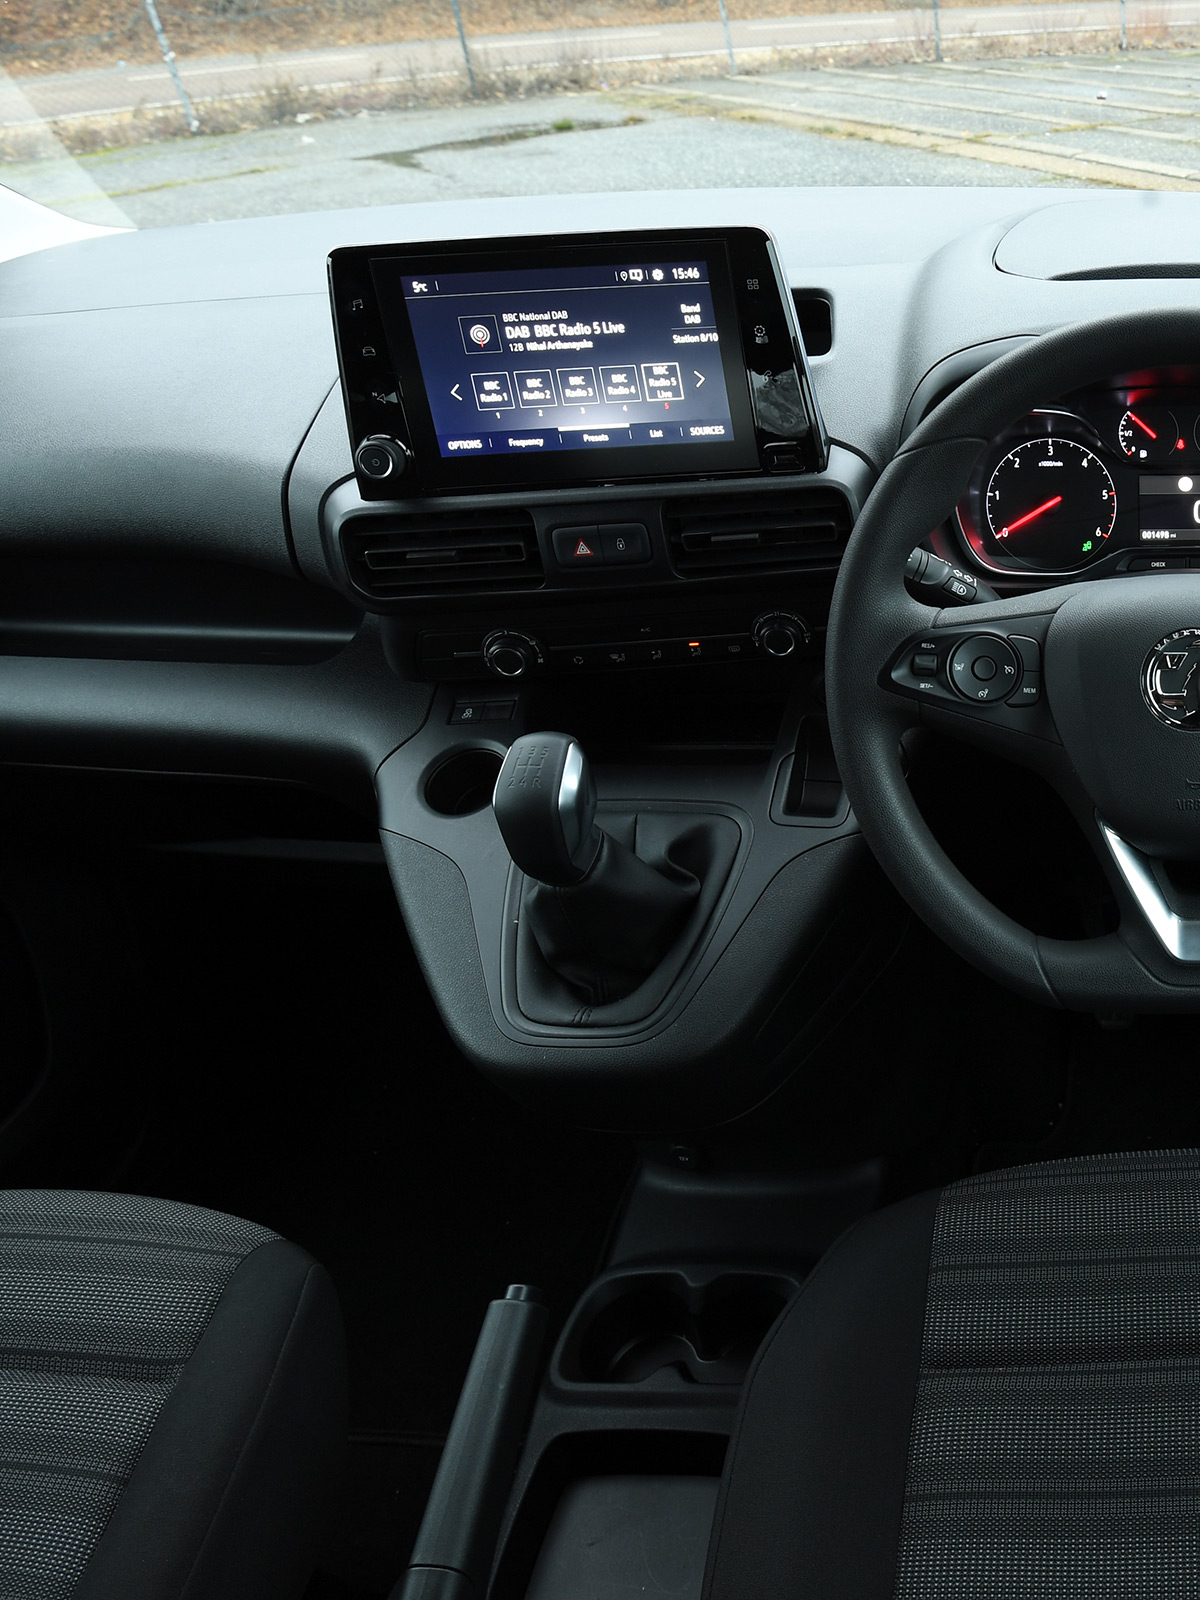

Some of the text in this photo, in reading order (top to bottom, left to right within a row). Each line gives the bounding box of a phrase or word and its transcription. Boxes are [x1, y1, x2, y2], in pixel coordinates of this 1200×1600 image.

[672, 267, 700, 280] 15:46
[680, 303, 701, 314] Band
[502, 310, 568, 322] BBC National DAB
[684, 314, 701, 324] DAB
[505, 321, 625, 339] DAB BBC Radio 5 Live
[672, 333, 700, 344] Station
[509, 342, 524, 352] 12B
[652, 366, 669, 375] BBC
[526, 378, 543, 388] BBC
[568, 376, 585, 386] BBC
[611, 374, 628, 383] BBC
[649, 377, 677, 387] Radio 5
[484, 381, 500, 391] BBC
[607, 385, 636, 395] Radio 4
[480, 392, 508, 403] Radio 1
[522, 390, 551, 401] Radio 2
[565, 387, 593, 398] Radio 3
[657, 390, 673, 399] Live
[664, 402, 670, 410] 5
[649, 429, 663, 438] List
[689, 425, 725, 437] SOURCES
[508, 438, 544, 448] Frequency
[582, 433, 609, 443] Presets
[447, 440, 482, 451] OPTIONS
[1047, 446, 1054, 456] 3
[1013, 458, 1020, 468] 2
[1081, 458, 1088, 468] 4
[994, 490, 1000, 501] 1
[1102, 490, 1109, 500] 5
[1002, 528, 1009, 538] 0
[1095, 527, 1102, 537] 6
[1141, 530, 1170, 540] 001498
[528, 745, 537, 757] 3
[540, 745, 550, 757] 5
[508, 775, 542, 789] 2 4 R
